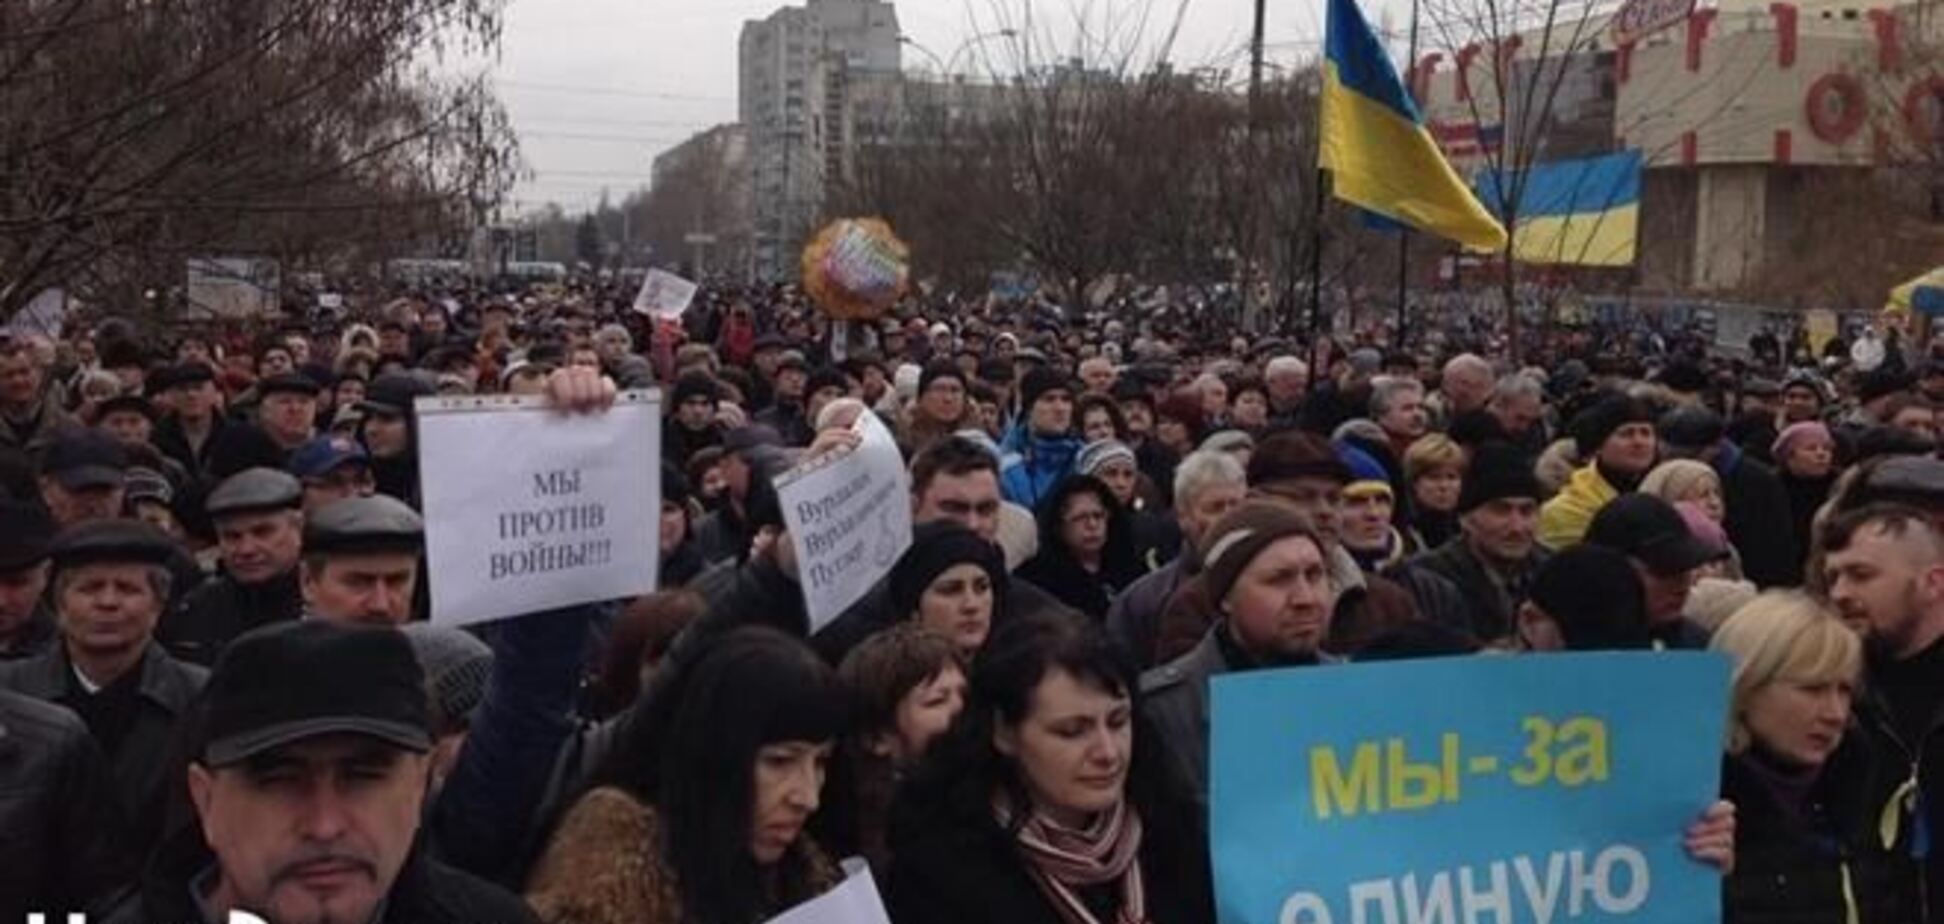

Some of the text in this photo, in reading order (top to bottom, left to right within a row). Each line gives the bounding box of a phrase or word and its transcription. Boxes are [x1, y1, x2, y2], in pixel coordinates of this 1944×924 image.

[533, 469, 581, 497] МЫ
[499, 504, 605, 540] ПРОТИВ
[490, 538, 612, 581] ВОЙНЫ!!!
